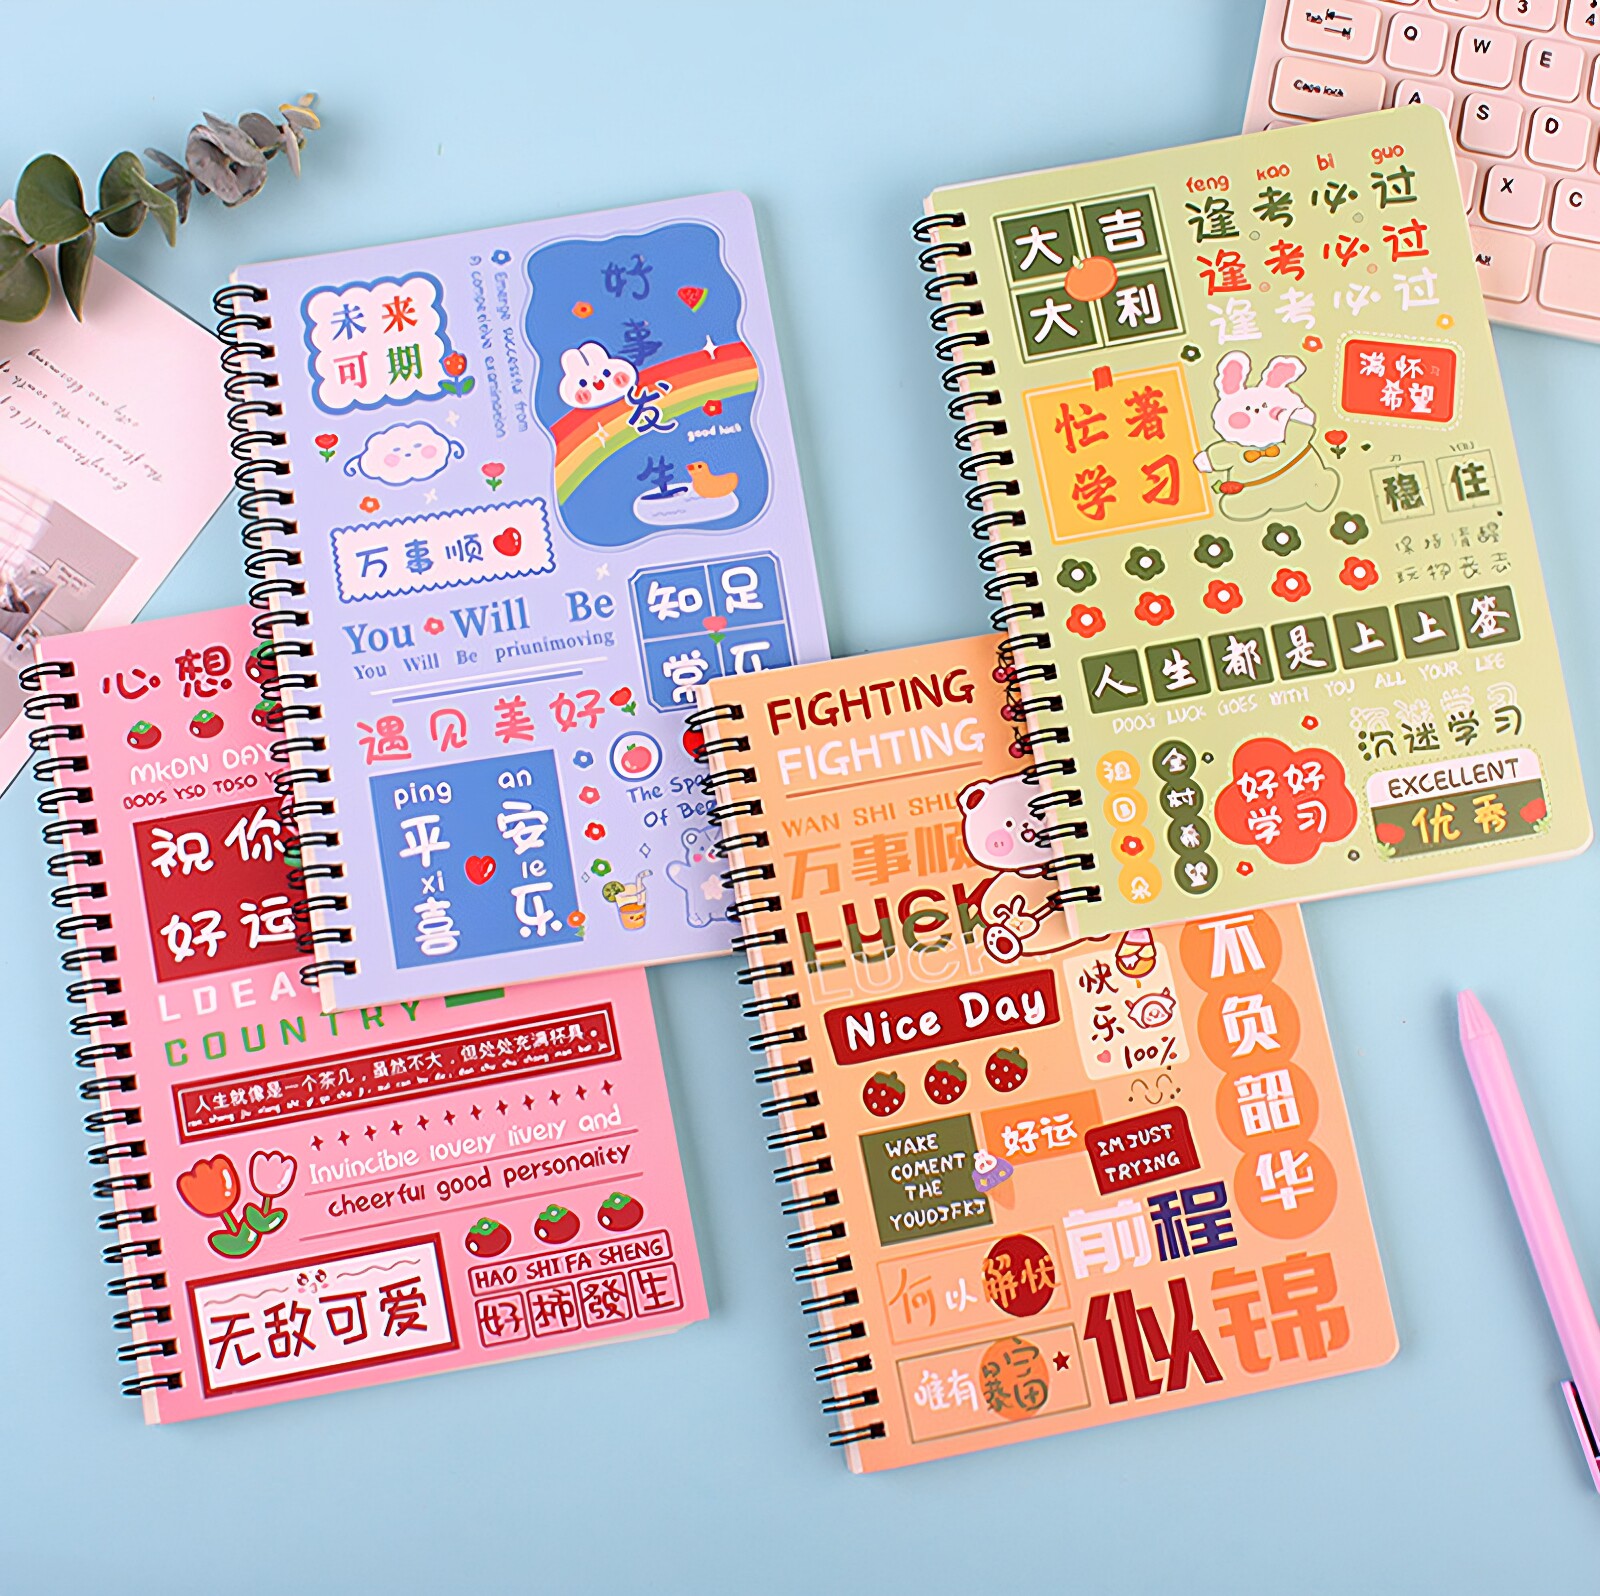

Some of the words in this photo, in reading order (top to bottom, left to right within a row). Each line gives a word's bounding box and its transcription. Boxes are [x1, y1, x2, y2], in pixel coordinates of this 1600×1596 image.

[1516, 0, 1528, 13] 3
[1473, 38, 1491, 54] W
[1540, 50, 1552, 68] E
[1476, 104, 1490, 121] S
[1186, 175, 1229, 193] feng
[1256, 164, 1290, 181] kao
[1316, 153, 1335, 171] bi
[1371, 144, 1405, 164] guo
[1500, 177, 1514, 194] X
[1185, 165, 1418, 243] 逢考必过
[1569, 191, 1583, 208] C
[1015, 207, 1144, 271] 大吉
[1196, 218, 1430, 296] 逢考必过
[331, 294, 419, 342] 未来
[1030, 282, 1163, 344] 大利
[1206, 266, 1441, 346] 逢考必过
[332, 343, 423, 391] 可期
[1379, 378, 1434, 414] 希望
[1071, 453, 1182, 522] 学习
[1382, 461, 1491, 513] 稳住
[355, 532, 485, 580] 万事顺
[646, 565, 764, 622] 知足
[342, 623, 415, 655] You
[450, 596, 530, 638] Will
[565, 590, 615, 623] Be
[1093, 595, 1512, 699] 人生都是上上签
[102, 645, 233, 700] 心想
[354, 663, 387, 680] You
[403, 652, 440, 673] Will
[456, 649, 478, 666] Be
[1217, 693, 1258, 717] GOES
[1324, 677, 1356, 698] YOU
[1374, 671, 1407, 689] ALL
[1418, 660, 1463, 682] YOUR
[1475, 651, 1506, 673] LIFE
[356, 688, 605, 765] 遇见美好
[767, 668, 975, 737] FIGHTING
[776, 717, 986, 786] FIGHTING
[1357, 704, 1522, 762] 沉迷学习
[393, 779, 453, 811] ping
[497, 767, 533, 791] an
[626, 785, 664, 804] The
[1236, 760, 1327, 801] 好好
[1387, 757, 1520, 799] EXCELLENT
[151, 806, 286, 878] 祝你
[398, 800, 549, 869] 平安
[643, 808, 668, 828] Of
[781, 811, 840, 839] WAN
[854, 801, 897, 827] SHI
[1246, 801, 1328, 847] 学习
[1411, 793, 1508, 844] 优秀
[420, 871, 445, 895] xi
[521, 858, 547, 880] le
[160, 895, 297, 964] 好运
[413, 881, 564, 957] 喜乐
[159, 970, 320, 1023] LDEA
[844, 1008, 943, 1053] Nice
[958, 988, 1048, 1032] Day
[1078, 959, 1127, 1044] 快乐
[164, 999, 420, 1068] COUNTRY
[1122, 1035, 1179, 1070] 100%
[1197, 913, 1317, 1212] 不负韶华
[309, 1147, 420, 1185] Invincible
[430, 1132, 497, 1163] lovely
[508, 1118, 568, 1148] lively
[578, 1103, 623, 1134] and
[884, 1132, 940, 1158] WAKE
[1000, 1113, 1079, 1158] 好运
[327, 1183, 426, 1218] cheerful
[436, 1165, 492, 1201] good
[503, 1144, 631, 1188] personality
[890, 1152, 967, 1182] COMENT
[904, 1178, 943, 1202] THE
[1104, 1150, 1182, 1184] TRYING
[1061, 1179, 1239, 1281] 前程
[475, 1265, 518, 1289] HAO
[526, 1257, 561, 1280] SHI
[565, 1251, 593, 1274] FA
[598, 1238, 664, 1267] SHENG
[208, 1276, 429, 1370] 无敌可爱
[1082, 1250, 1353, 1405] 似锦
